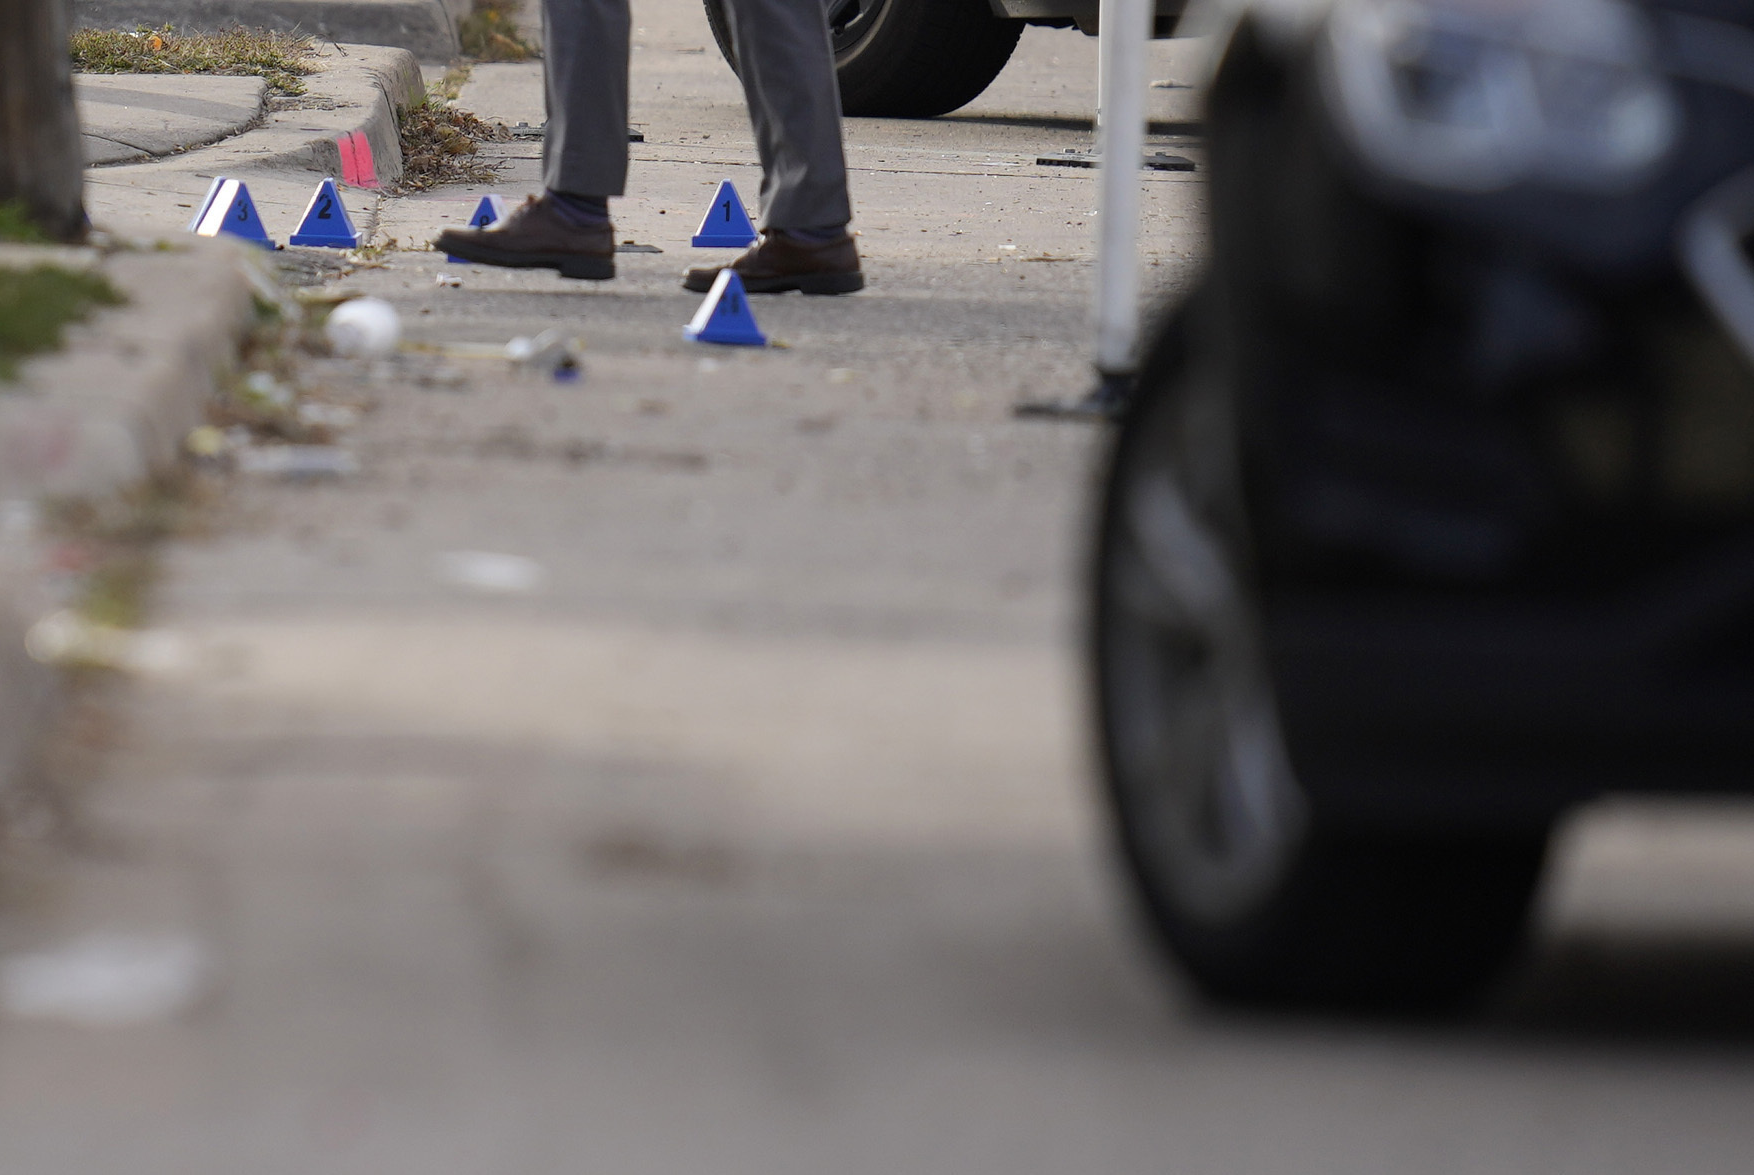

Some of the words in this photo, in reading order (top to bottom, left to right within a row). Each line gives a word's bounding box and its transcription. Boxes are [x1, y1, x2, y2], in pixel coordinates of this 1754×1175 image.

[237, 200, 248, 222] 3
[317, 193, 332, 220] 2
[722, 200, 731, 222] 1
